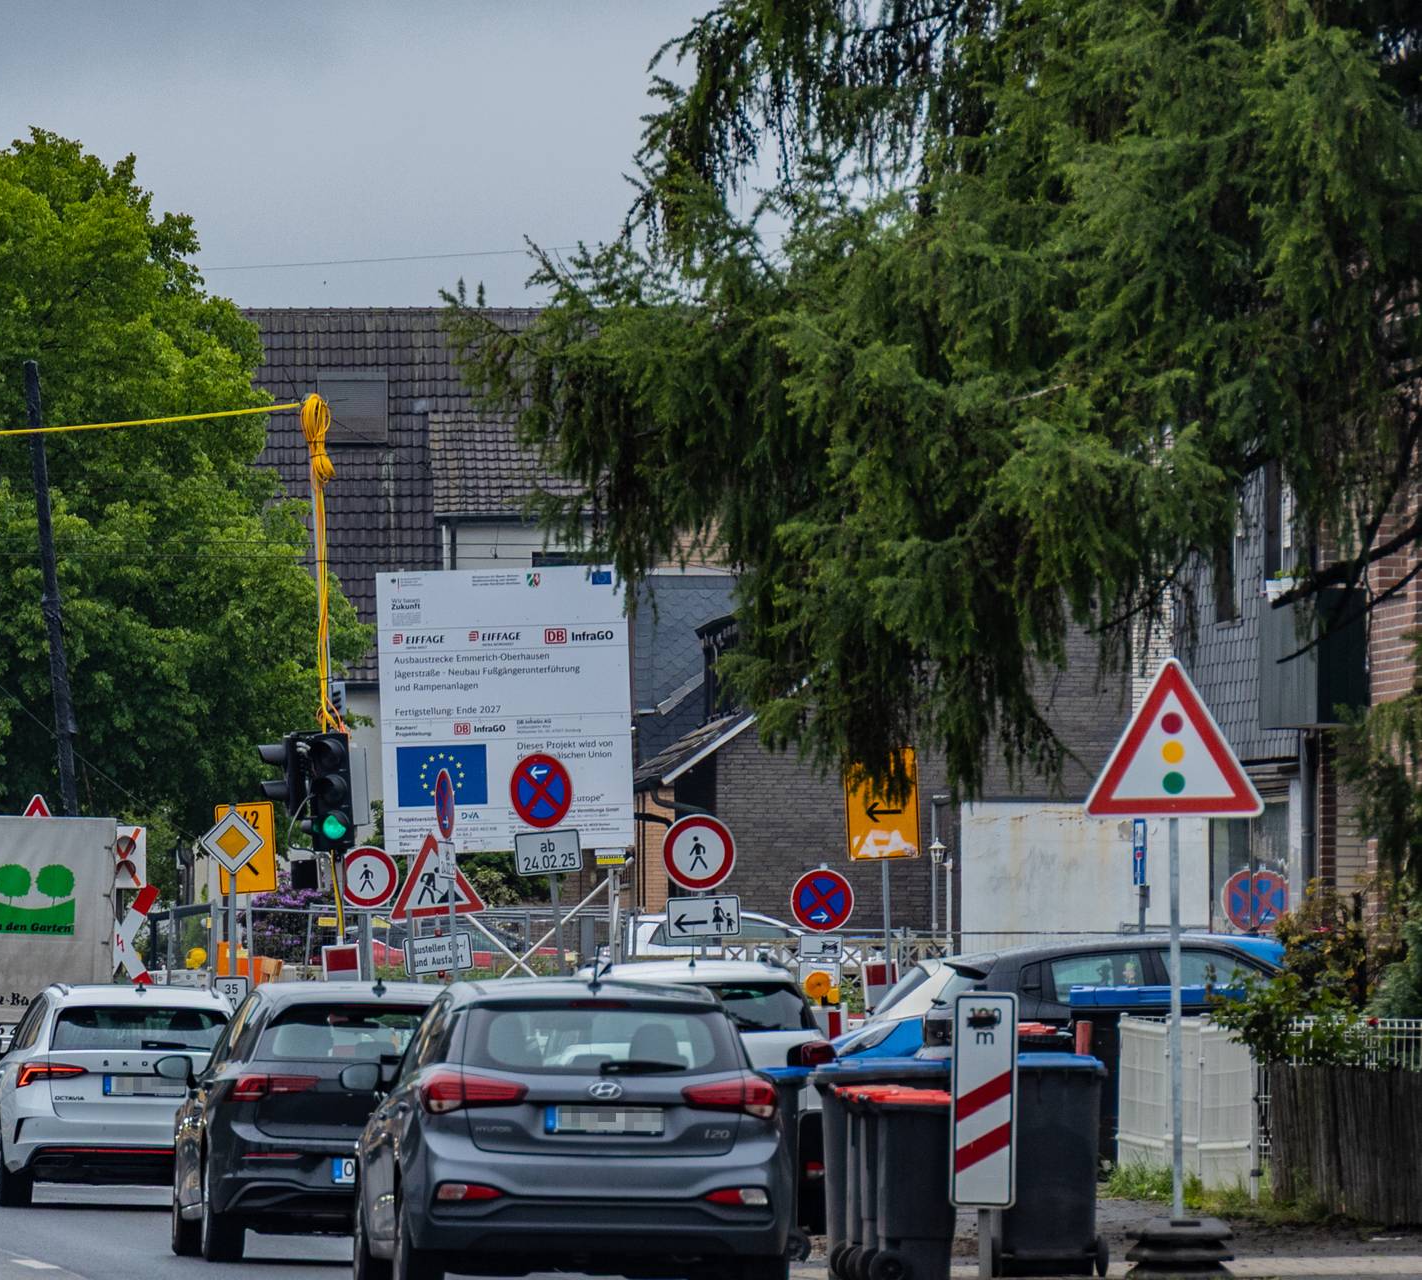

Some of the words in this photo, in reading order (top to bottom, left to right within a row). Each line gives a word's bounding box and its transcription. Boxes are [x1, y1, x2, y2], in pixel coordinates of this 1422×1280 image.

[406, 634, 445, 645] EIFFAGE
[482, 631, 521, 641] EIFFAGE
[547, 630, 565, 642] DB
[571, 630, 614, 642] InfraGO
[394, 655, 454, 665] Ausbaustrecke
[456, 652, 550, 663] Emmerich-Oberhausen
[394, 669, 440, 679] Jägerstraße
[448, 668, 480, 676] Neubau
[482, 664, 580, 677] Fußgängerunterführung
[395, 684, 411, 692] und
[413, 682, 479, 692] Rampenanlagen
[395, 707, 454, 717] Fertigstellung:
[456, 706, 477, 714] Ende
[480, 705, 501, 713] 2027
[456, 725, 469, 734] DB
[474, 725, 506, 733] InfraGO
[517, 742, 544, 750] Dieses
[546, 740, 576, 750] Projekt
[579, 740, 596, 748] wird
[588, 751, 612, 759] Union
[540, 839, 555, 853] ab
[524, 853, 576, 871] 24.02.25
[6, 922, 27, 932] den
[31, 923, 71, 933] Garten
[432, 954, 464, 966] Ausfart
[225, 984, 238, 994] 35
[976, 1031, 994, 1045] m
